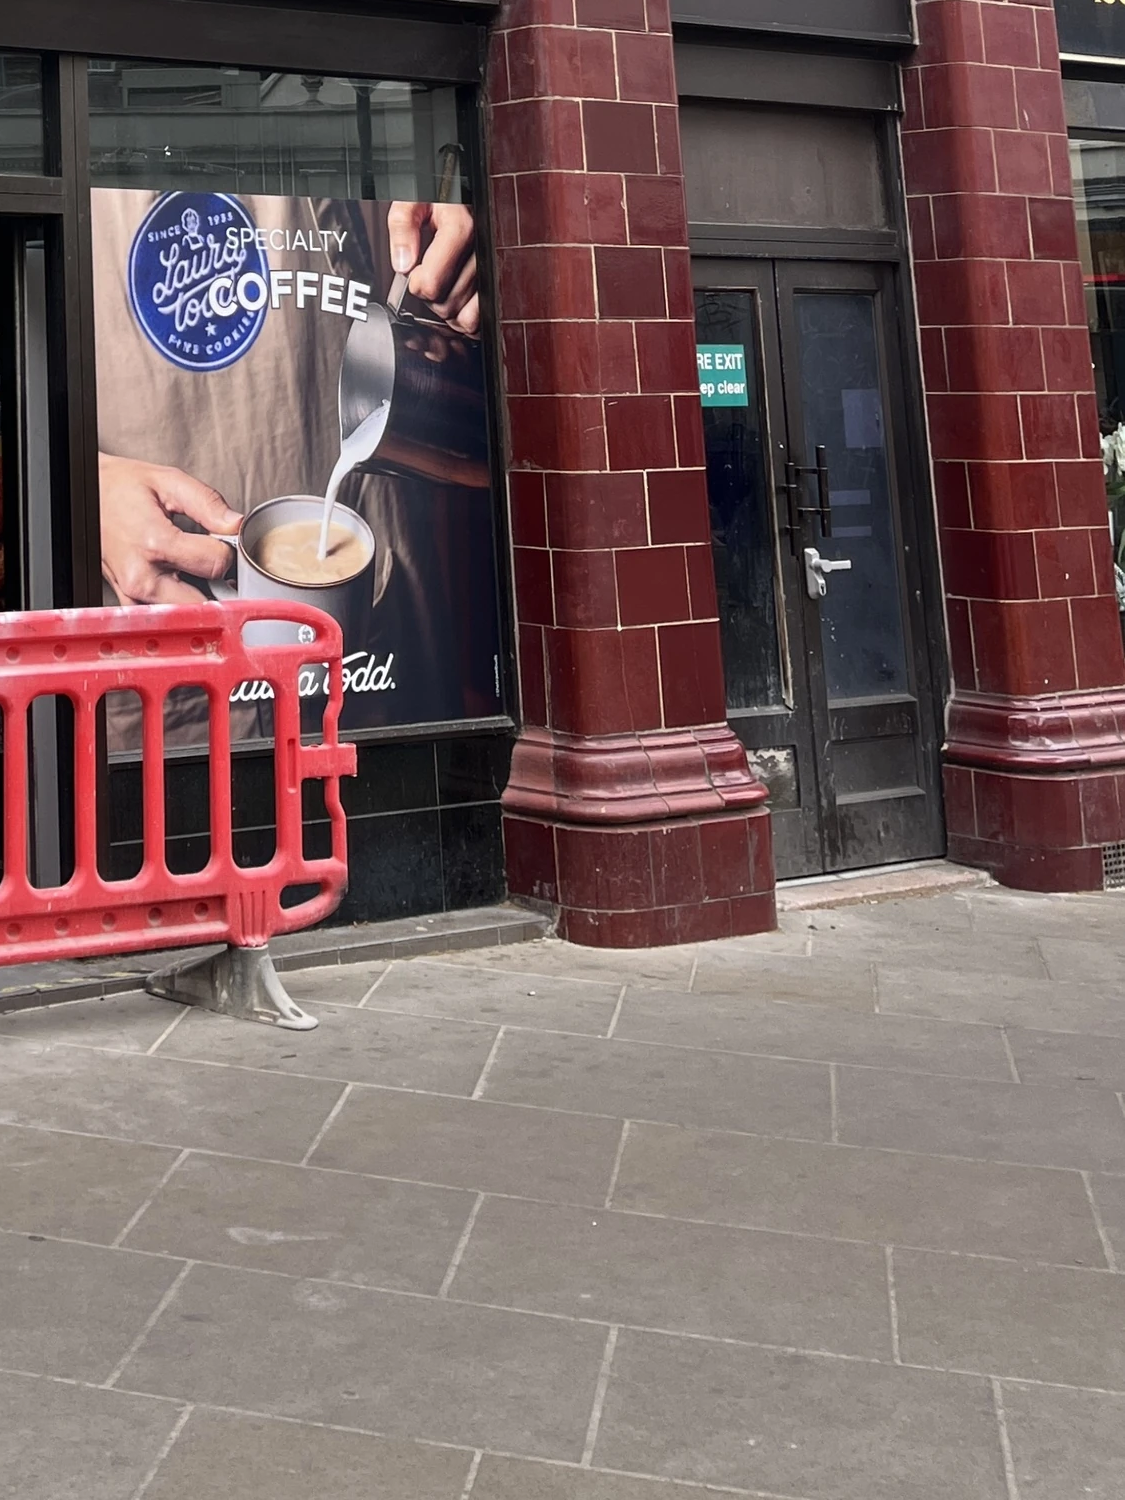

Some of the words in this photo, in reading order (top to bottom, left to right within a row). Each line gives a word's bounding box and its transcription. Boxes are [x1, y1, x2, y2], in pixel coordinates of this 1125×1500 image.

[148, 225, 181, 242] SINCE
[226, 227, 347, 252] SPECIALTY
[208, 270, 371, 322] COFFEE
[696, 353, 713, 370] RE
[715, 353, 743, 370] EXIT
[700, 383, 714, 398] ep
[717, 380, 745, 394] clear
